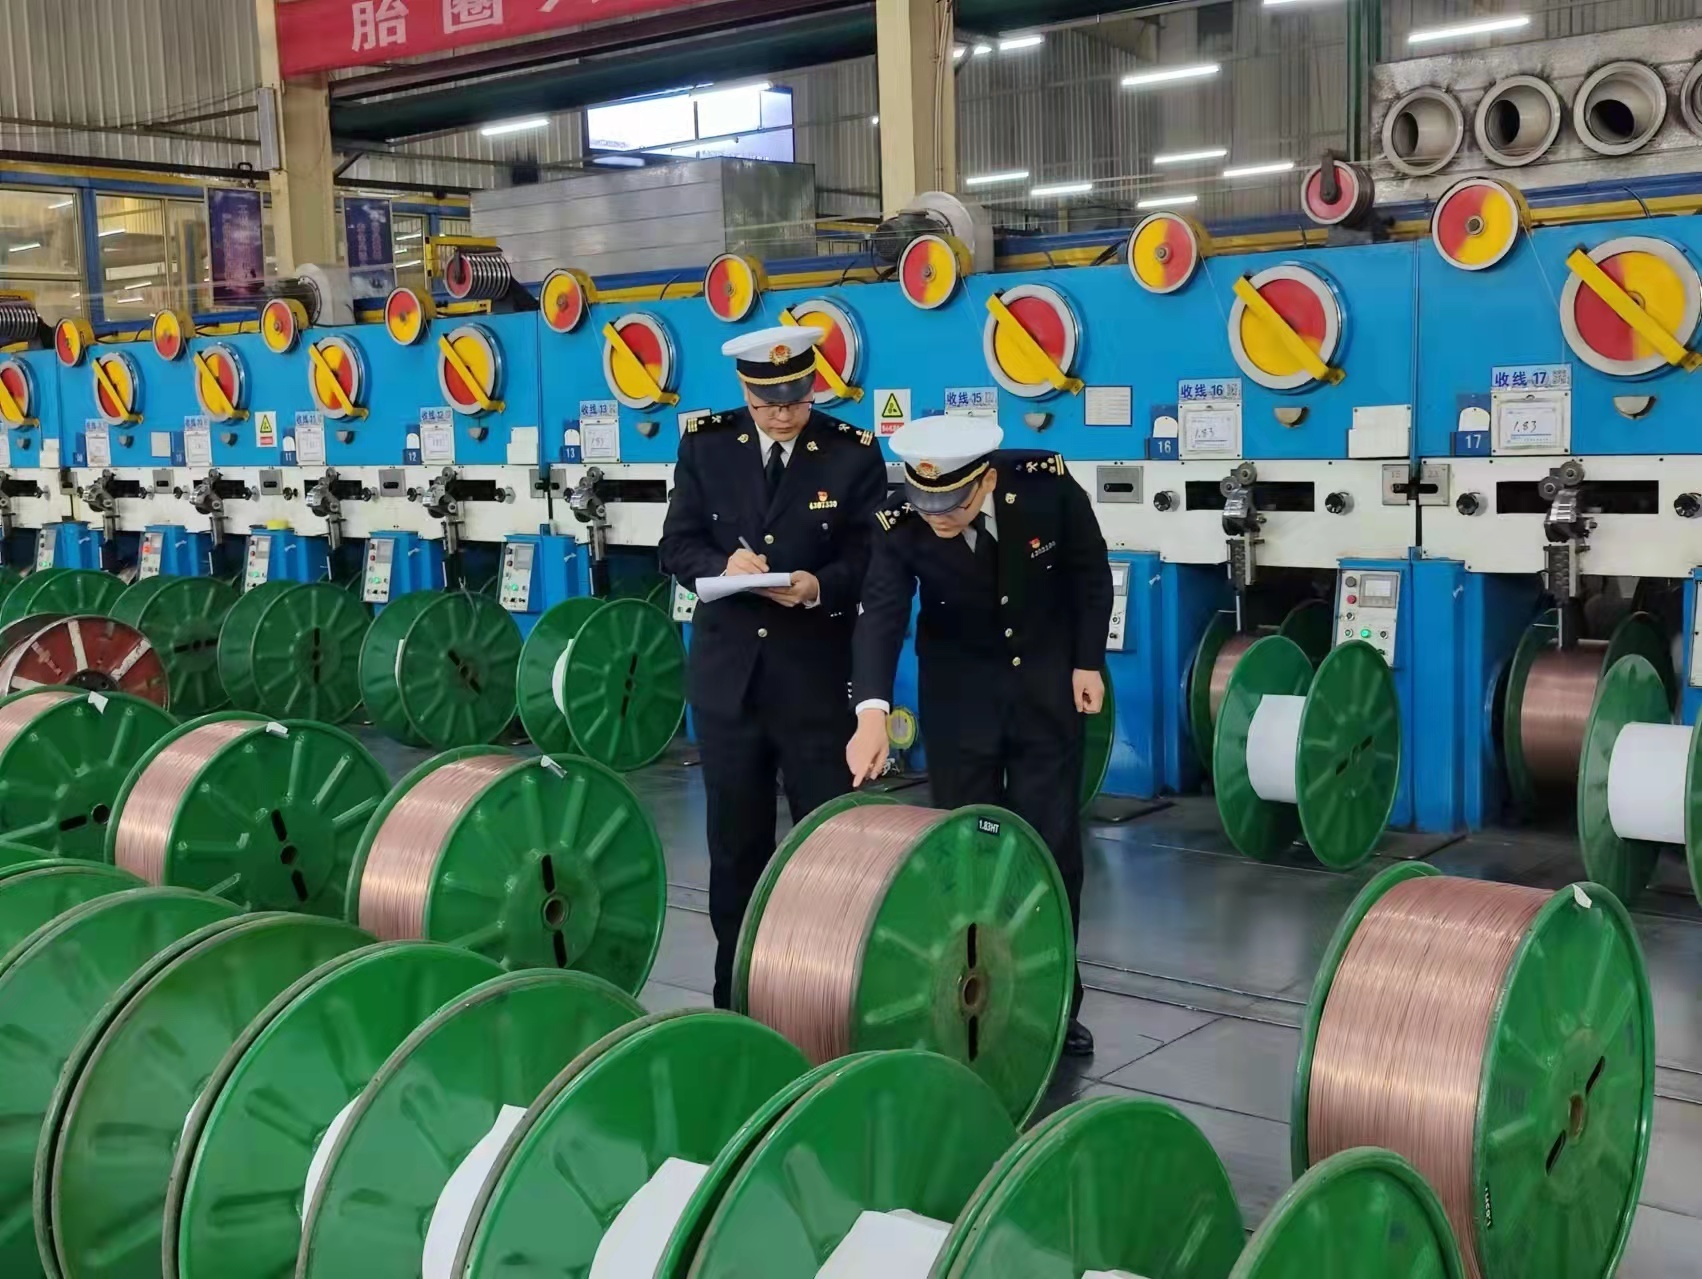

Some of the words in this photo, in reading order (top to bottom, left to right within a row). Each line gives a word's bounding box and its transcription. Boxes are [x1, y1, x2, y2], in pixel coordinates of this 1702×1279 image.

[351, 0, 601, 51] 胎圈
[1158, 440, 1172, 454] 16
[1465, 434, 1481, 449] 17
[408, 451, 417, 461] 12
[566, 447, 575, 458] 13
[979, 819, 1000, 834] 1.83HT
